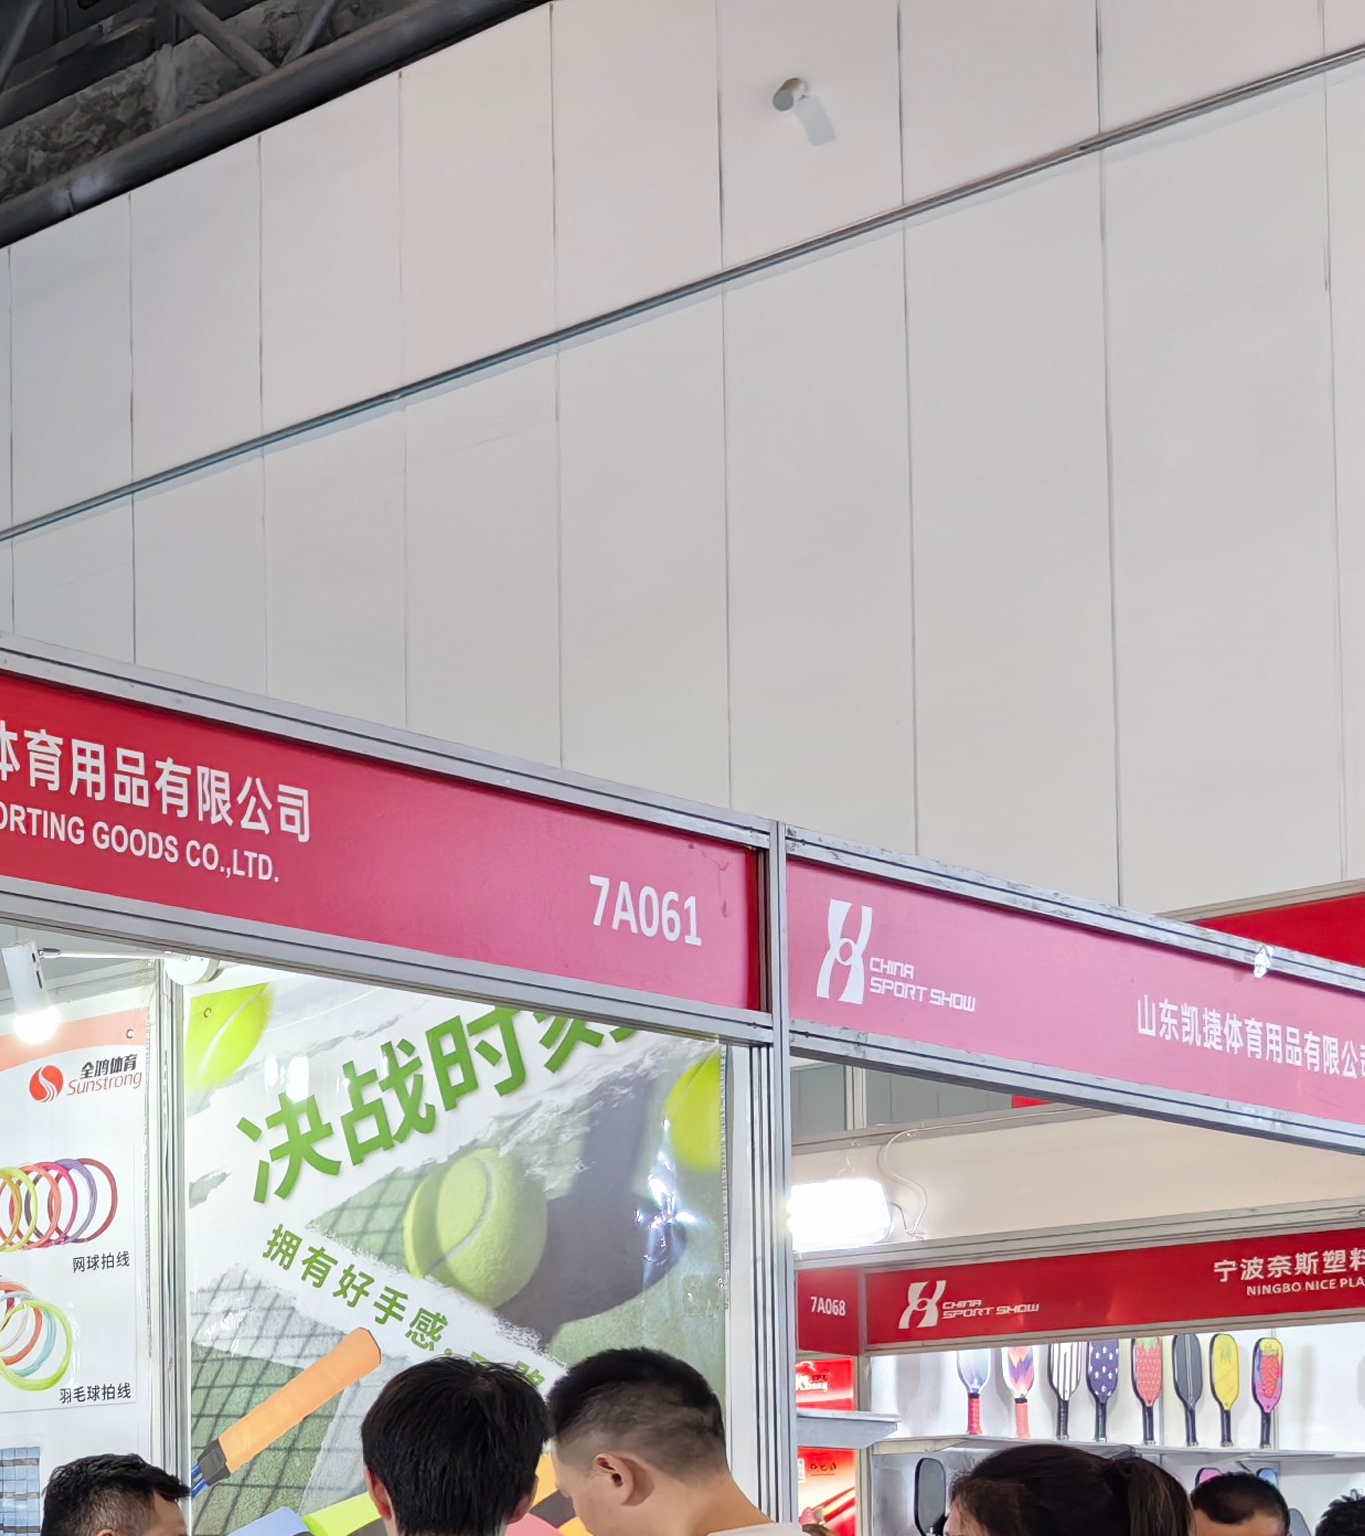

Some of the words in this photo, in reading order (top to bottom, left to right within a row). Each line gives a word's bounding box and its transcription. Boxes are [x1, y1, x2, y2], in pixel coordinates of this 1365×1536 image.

[92, 822, 179, 865] GOODS
[184, 839, 279, 885] CO.,LTD.
[588, 873, 701, 948] 7A061
[870, 957, 914, 980] CHINA
[870, 976, 926, 1004] SPORT
[929, 987, 976, 1013] SHOW
[80, 1053, 137, 1079] 全鸿体育
[66, 1072, 142, 1097] Sunstrong
[73, 1251, 130, 1273] 网球拍线
[1247, 1282, 1301, 1296] NINGBO
[1305, 1279, 1336, 1291] NICE
[810, 1296, 846, 1317] 7A068
[943, 1299, 982, 1311] CHINA
[943, 1307, 995, 1320] SPORT
[996, 1303, 1039, 1317] SHOW
[60, 1382, 131, 1403] 羽毛球拍线
